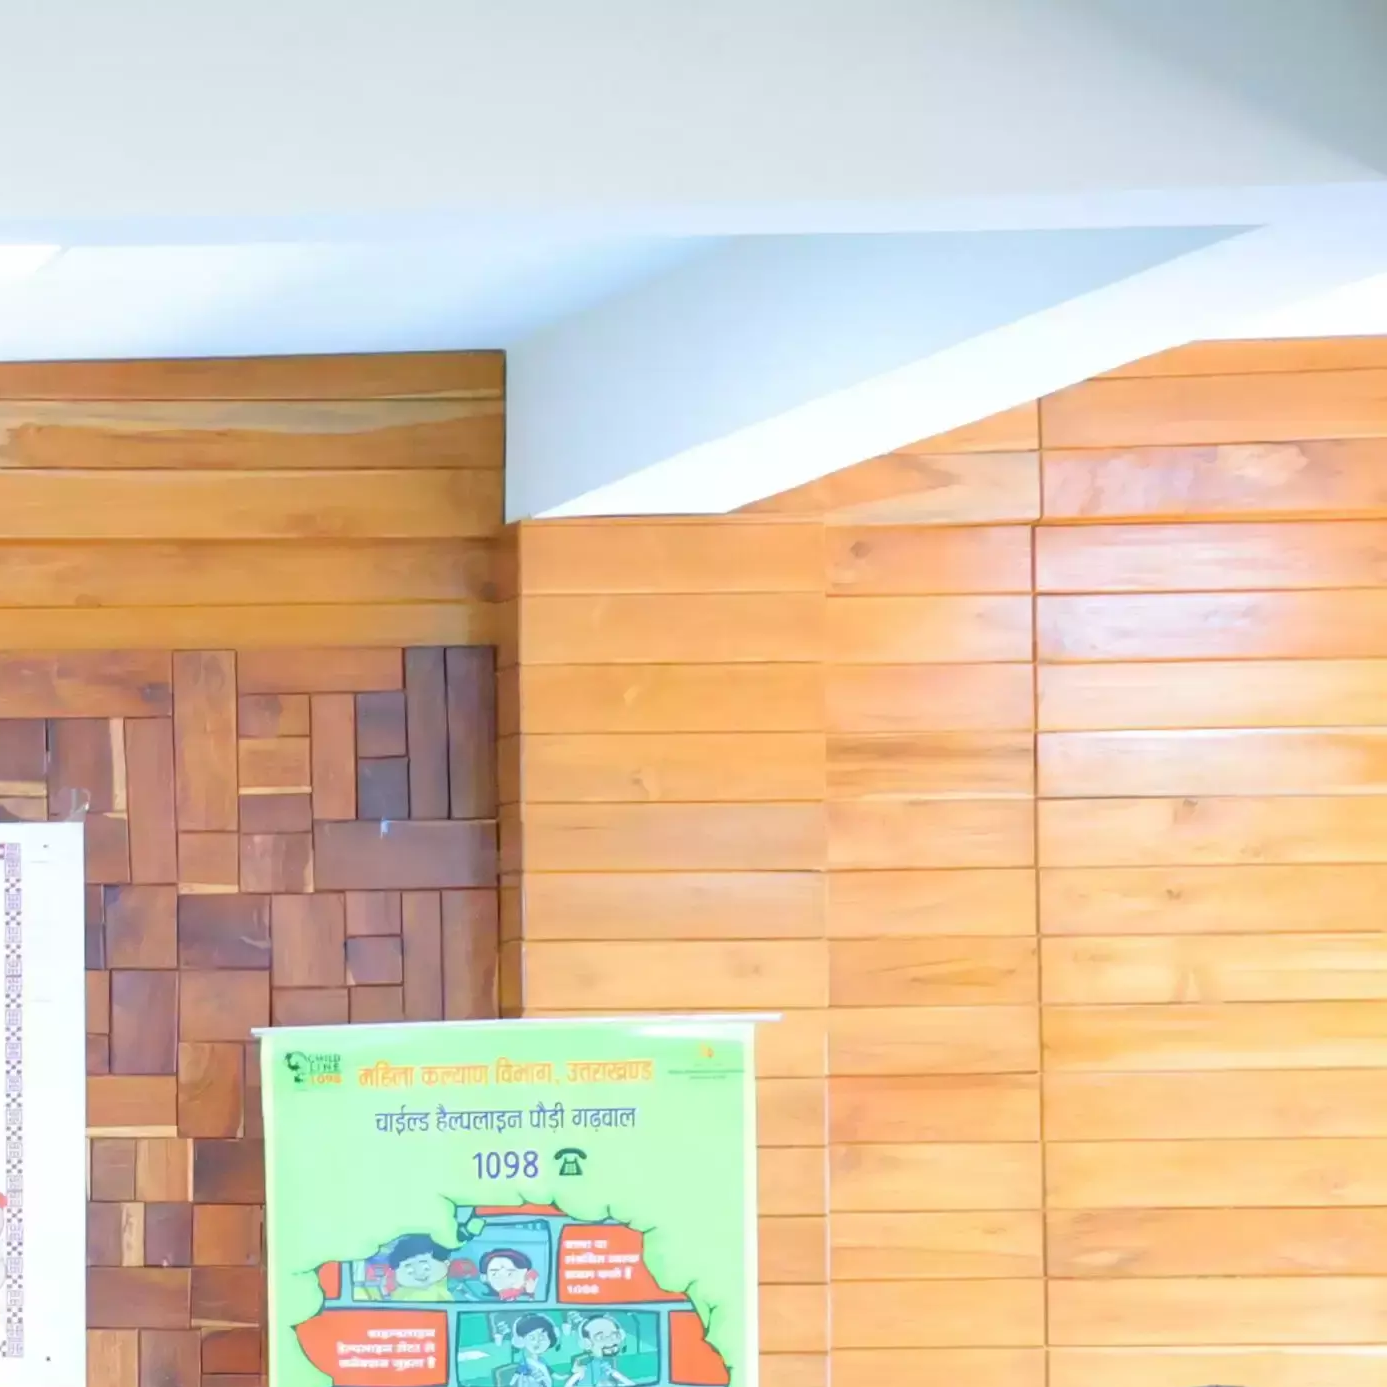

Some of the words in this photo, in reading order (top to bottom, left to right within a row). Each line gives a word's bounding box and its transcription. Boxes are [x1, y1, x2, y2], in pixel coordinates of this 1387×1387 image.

[358, 1060, 415, 1087] महिला
[421, 1063, 489, 1086] कल्याण
[566, 1057, 654, 1084] उत्तराखण्ड
[374, 1104, 431, 1137] चाईल्ड
[529, 1101, 565, 1134] पौड़ी
[571, 1107, 637, 1132] गढ़वाल
[472, 1150, 539, 1180] 1098
